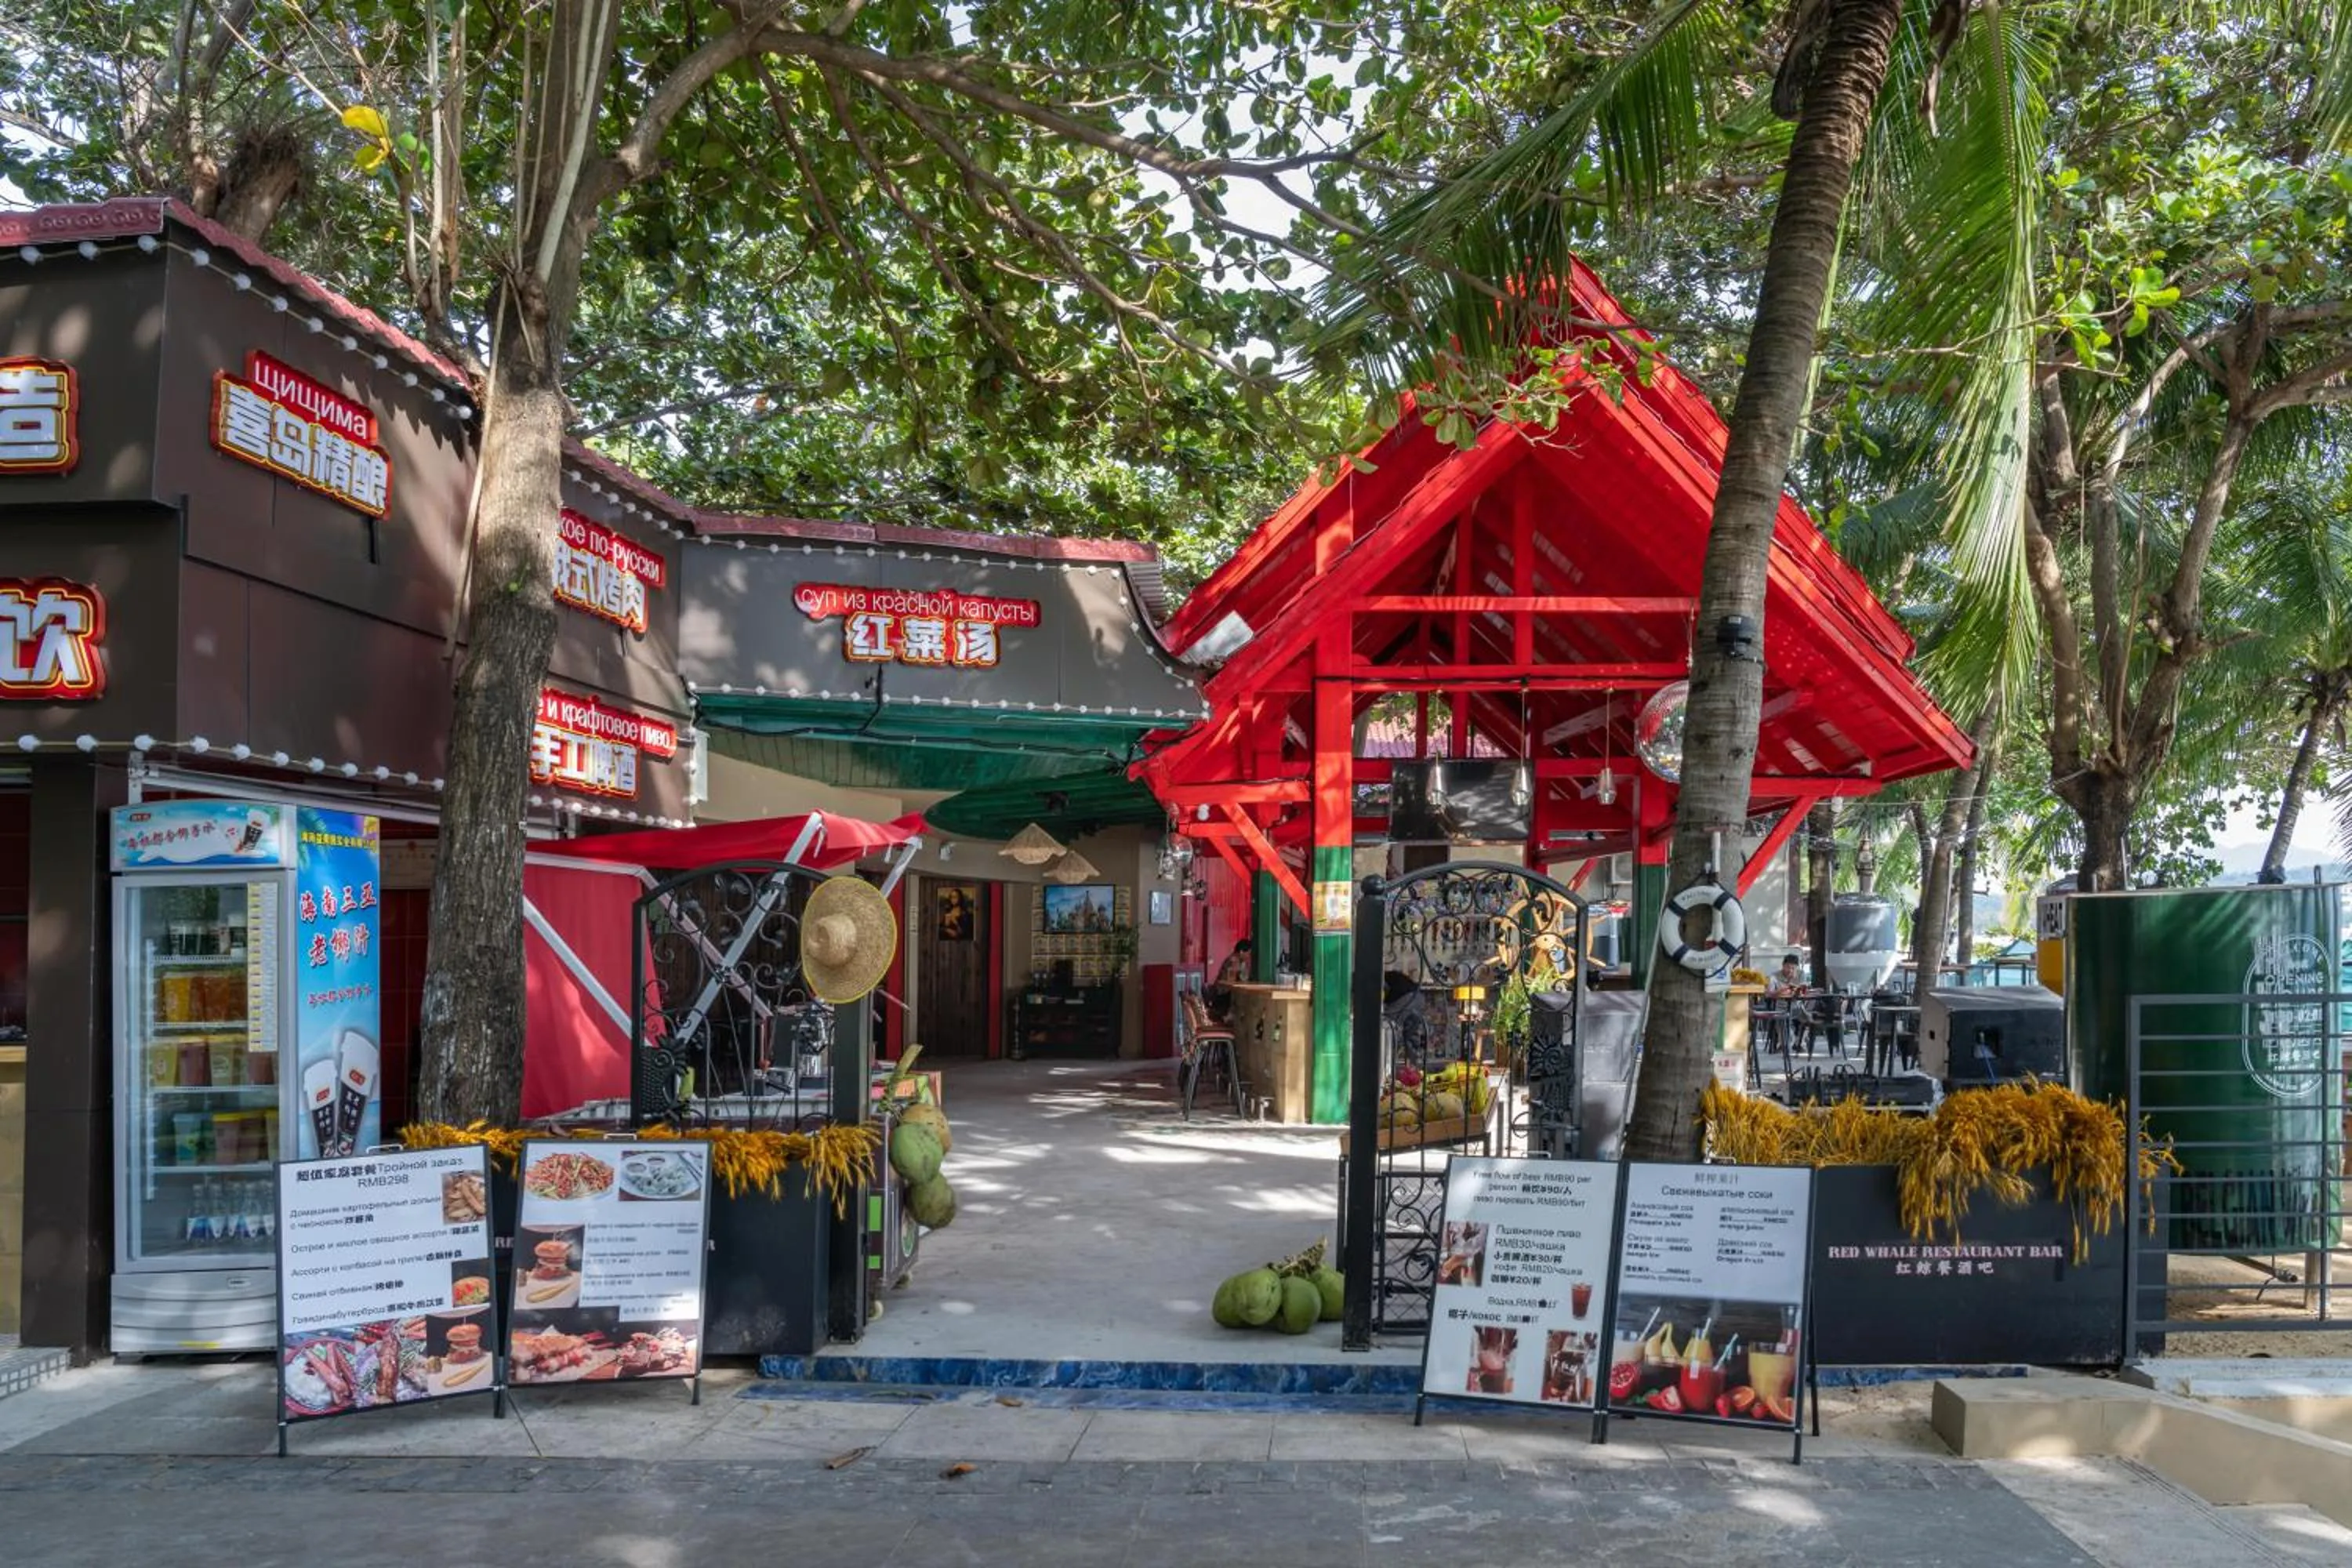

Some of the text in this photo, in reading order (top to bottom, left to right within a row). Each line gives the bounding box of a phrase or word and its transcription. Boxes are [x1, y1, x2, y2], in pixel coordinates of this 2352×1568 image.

[226, 384, 387, 512] 喜岛精酿
[589, 531, 660, 583] по-русски
[844, 592, 866, 610] из
[873, 593, 953, 616] красной
[959, 600, 1035, 622] капусты
[852, 615, 996, 662] 红菜汤
[561, 699, 638, 741] крафтовое
[1828, 1245, 2063, 1259] RED WHALE RESTAURANT BAR
[1896, 1260, 1994, 1276] 红鲸餐酒吧
